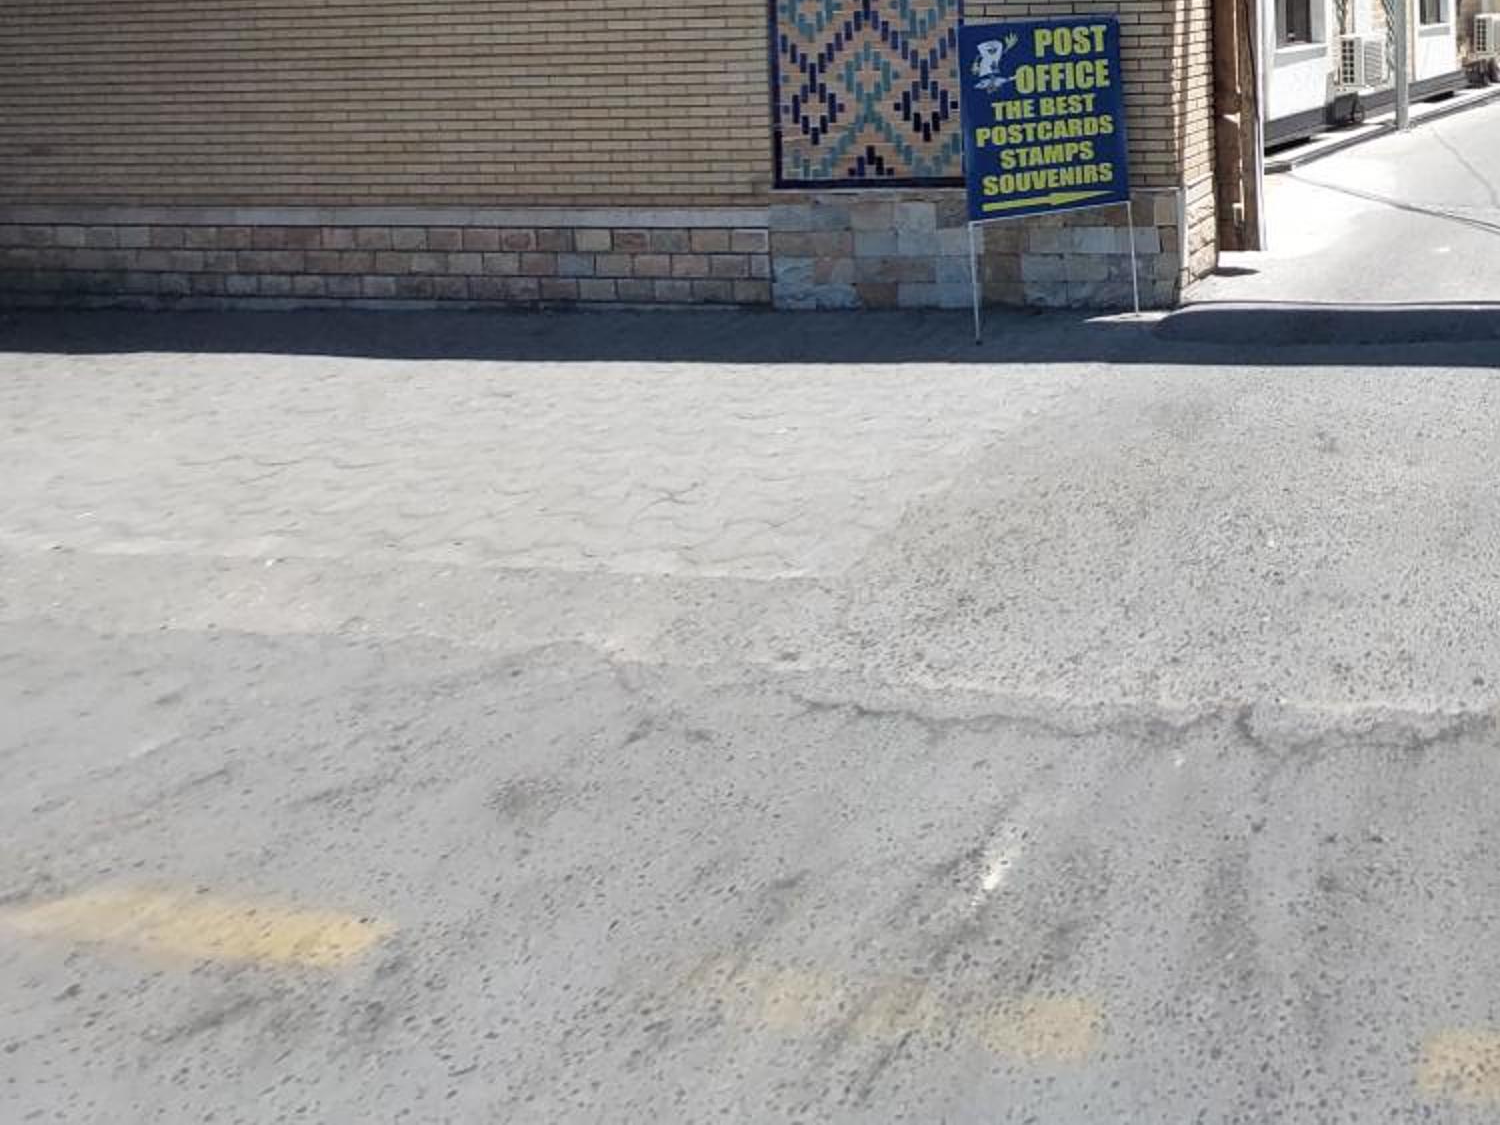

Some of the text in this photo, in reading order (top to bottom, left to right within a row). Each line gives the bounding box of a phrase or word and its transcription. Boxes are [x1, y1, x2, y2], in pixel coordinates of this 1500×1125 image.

[1034, 25, 1107, 57] POST
[1015, 59, 1111, 93] OFFICE
[992, 93, 1096, 121] THE BEST
[975, 115, 1113, 147] POSTCARDS
[1000, 140, 1095, 169] STAMPS
[982, 163, 1113, 195] SOUVENIRS
